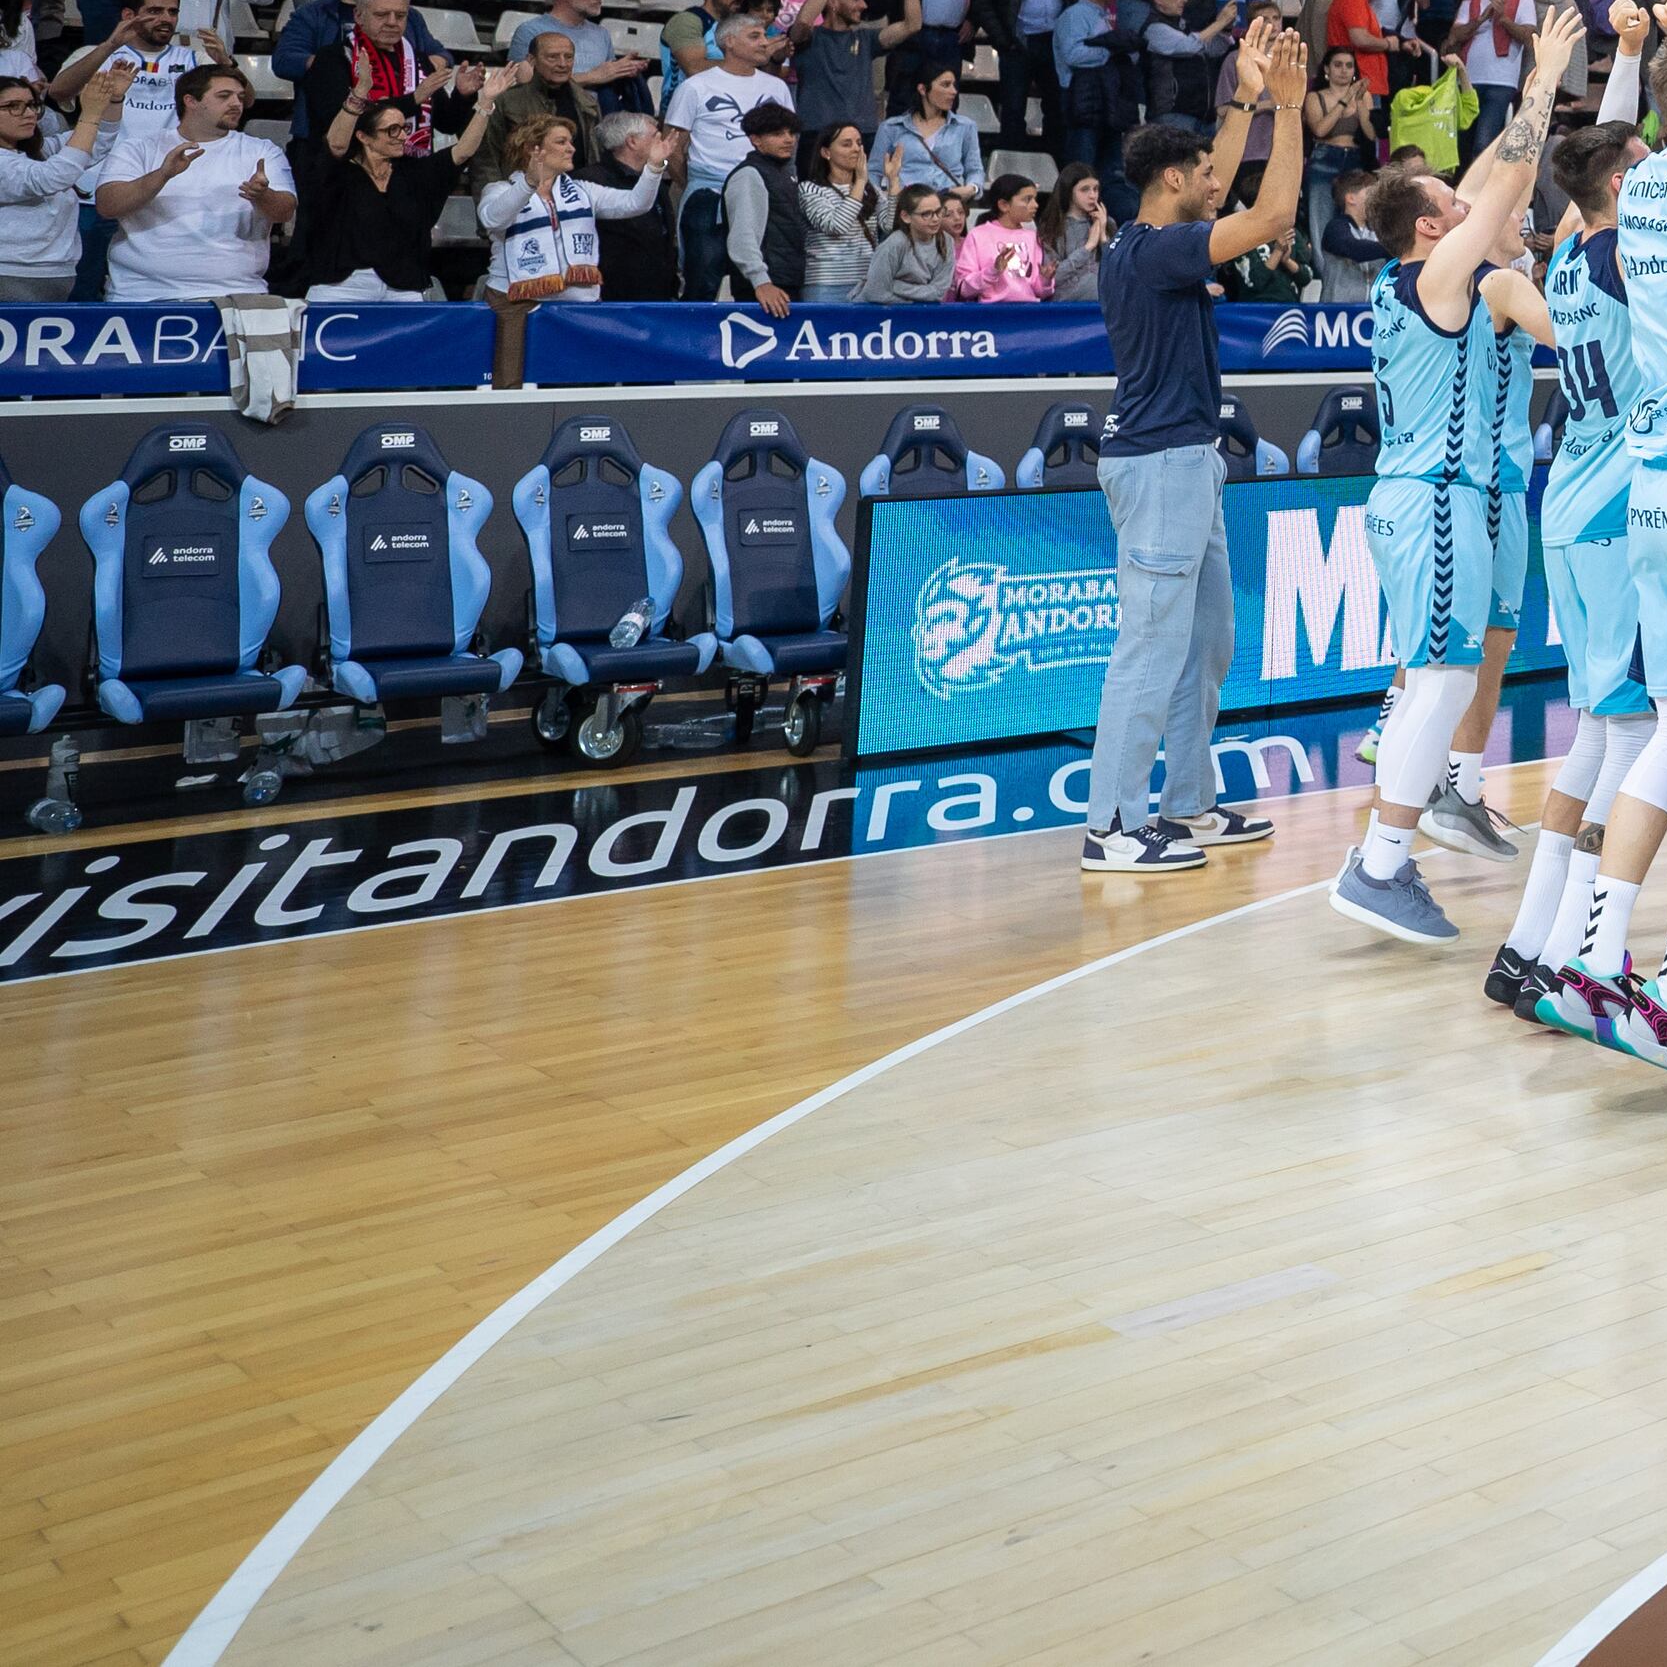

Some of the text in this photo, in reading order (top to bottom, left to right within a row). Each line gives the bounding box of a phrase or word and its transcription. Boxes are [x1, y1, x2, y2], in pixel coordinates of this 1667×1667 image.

[784, 317, 1000, 363] Andorra
[1220, 406, 1236, 417] MP
[913, 417, 941, 428] OMP
[1064, 413, 1089, 425] OMP
[579, 428, 612, 440] OMP
[749, 423, 779, 435] OMP
[169, 437, 206, 449] OMP
[381, 434, 416, 447] OMP
[591, 523, 626, 532] andorra
[762, 518, 794, 528] andorra
[592, 530, 628, 539] telecom
[762, 526, 796, 535] telecom
[390, 533, 428, 543] andorra
[390, 540, 430, 550] telecom
[172, 546, 215, 556] andorra
[172, 553, 216, 563] telecom
